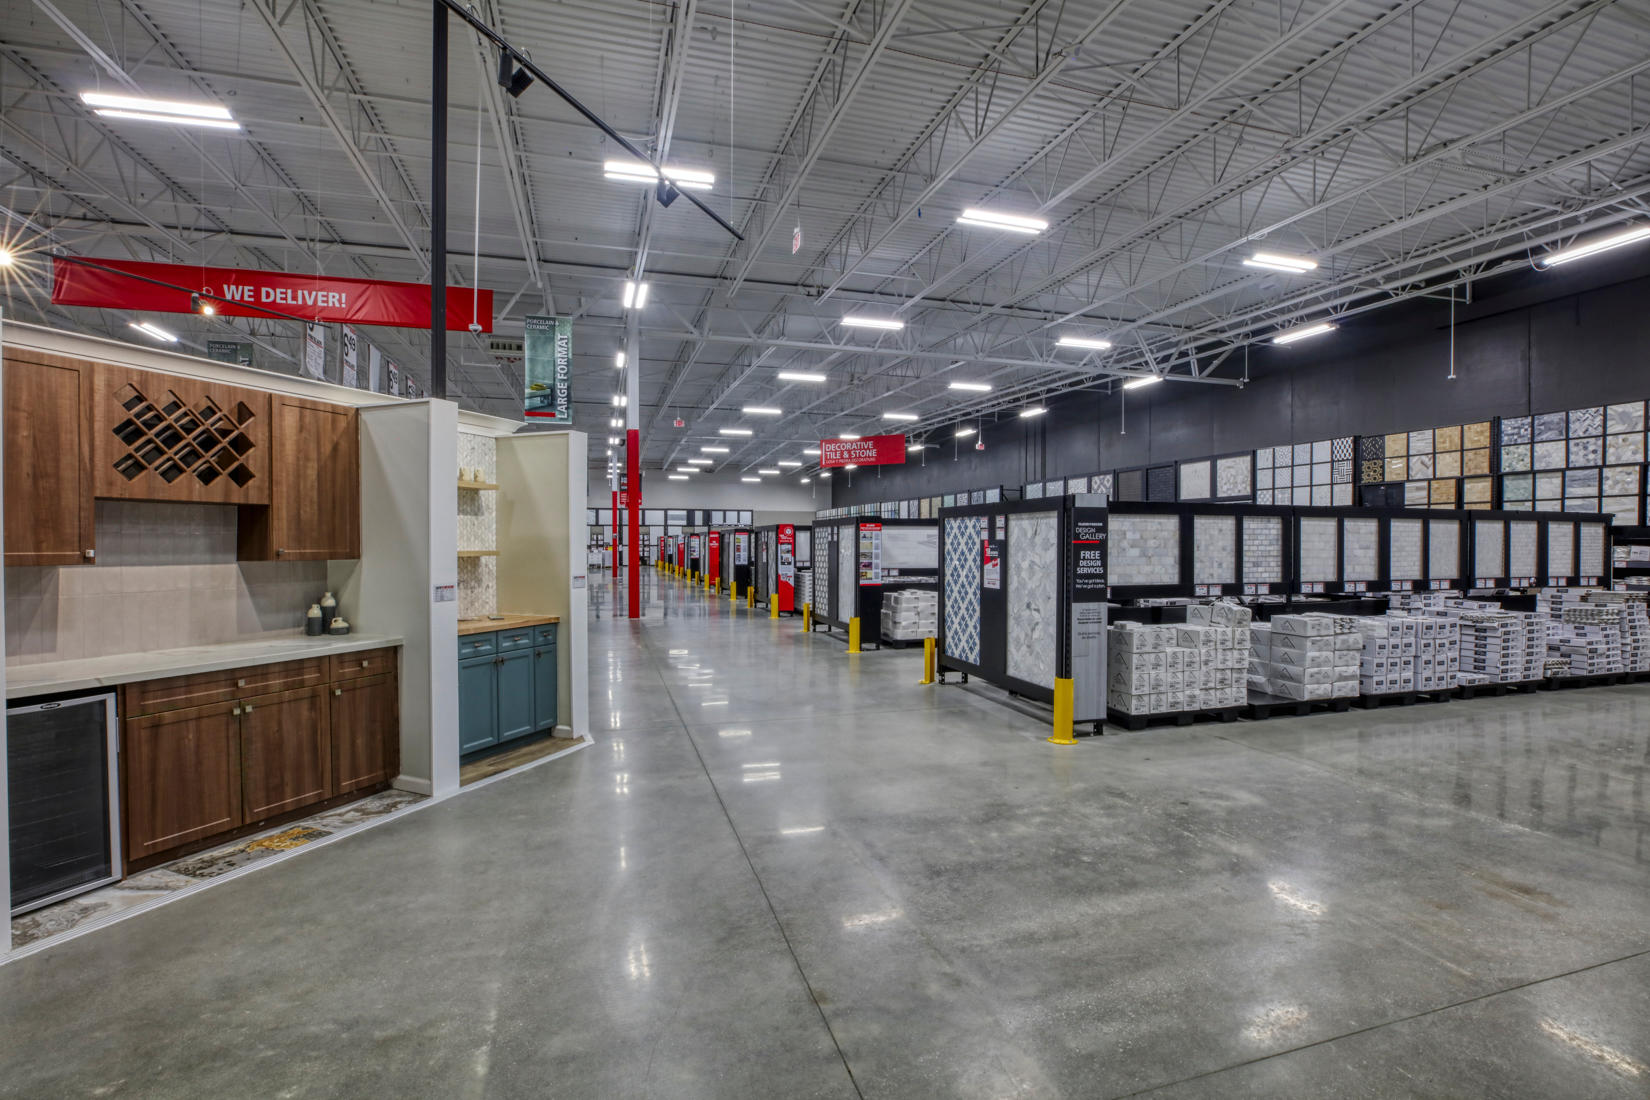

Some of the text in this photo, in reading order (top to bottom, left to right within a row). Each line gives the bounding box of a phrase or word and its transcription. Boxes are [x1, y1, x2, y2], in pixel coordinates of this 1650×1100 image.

[223, 284, 346, 308] WE DELIVER!
[557, 332, 568, 418] LARGE FORMAT
[825, 441, 874, 451] DECORATIVE
[827, 449, 877, 459] TILE & STONE
[1080, 551, 1101, 559] FREE
